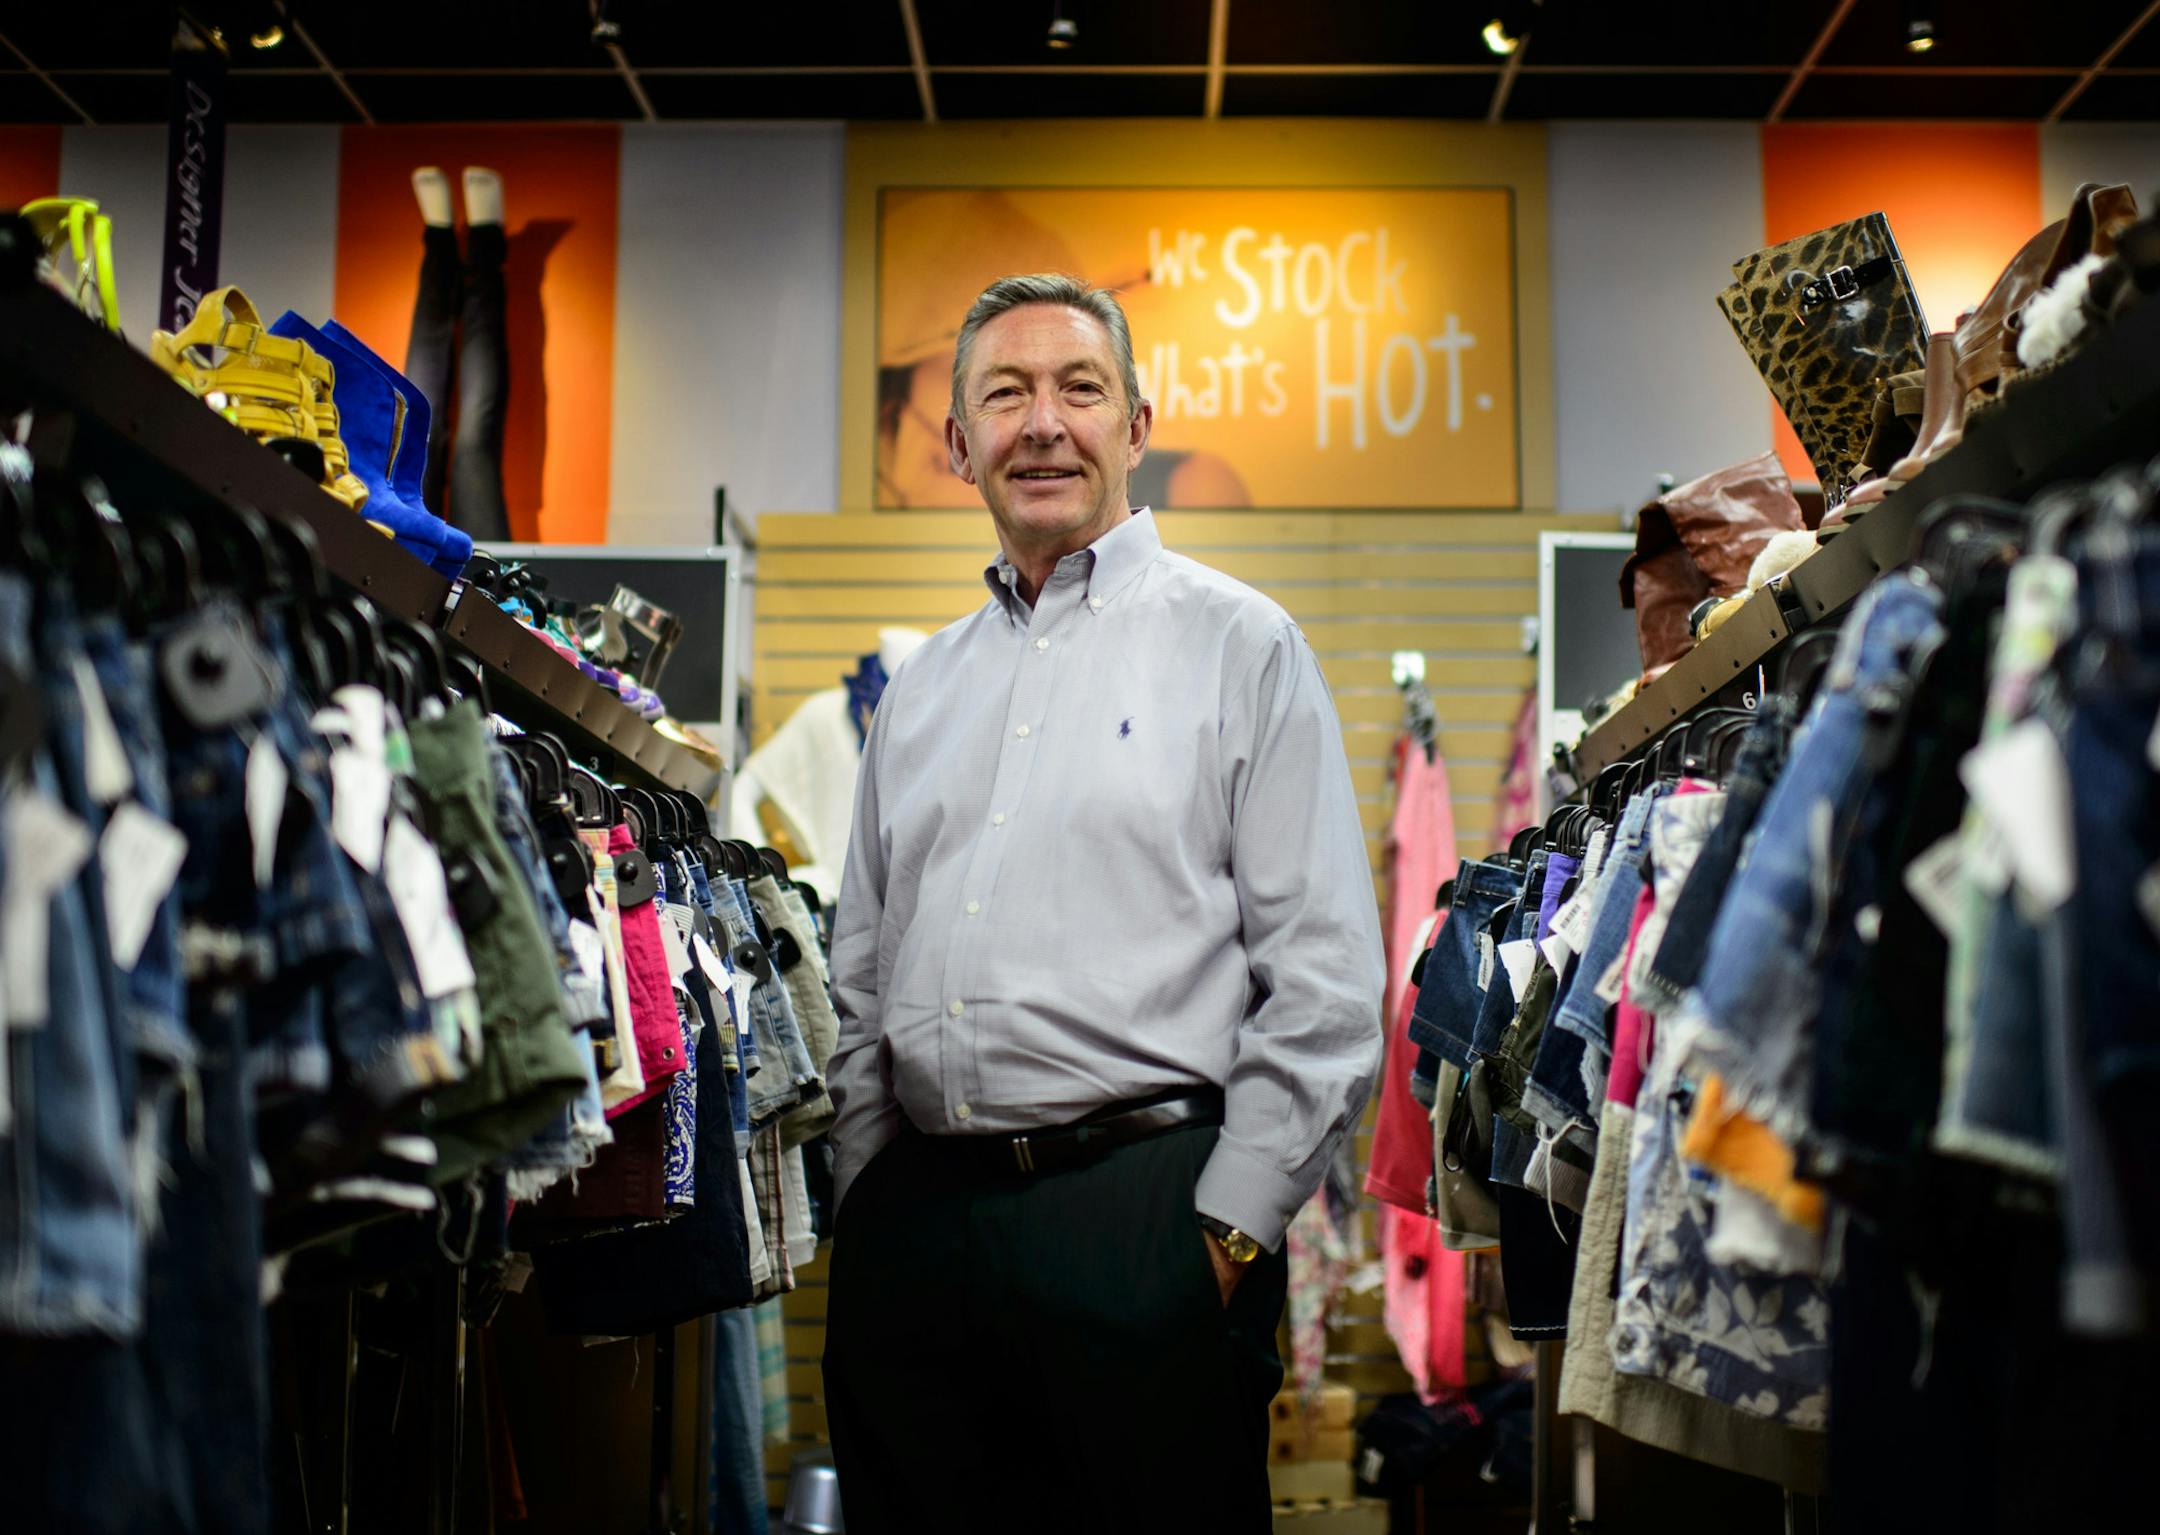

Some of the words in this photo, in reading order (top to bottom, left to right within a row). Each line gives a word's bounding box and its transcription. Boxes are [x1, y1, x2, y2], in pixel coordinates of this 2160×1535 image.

[1213, 225, 1409, 328] Stock
[1742, 691, 1757, 710] 6
[589, 755, 599, 771] 3
